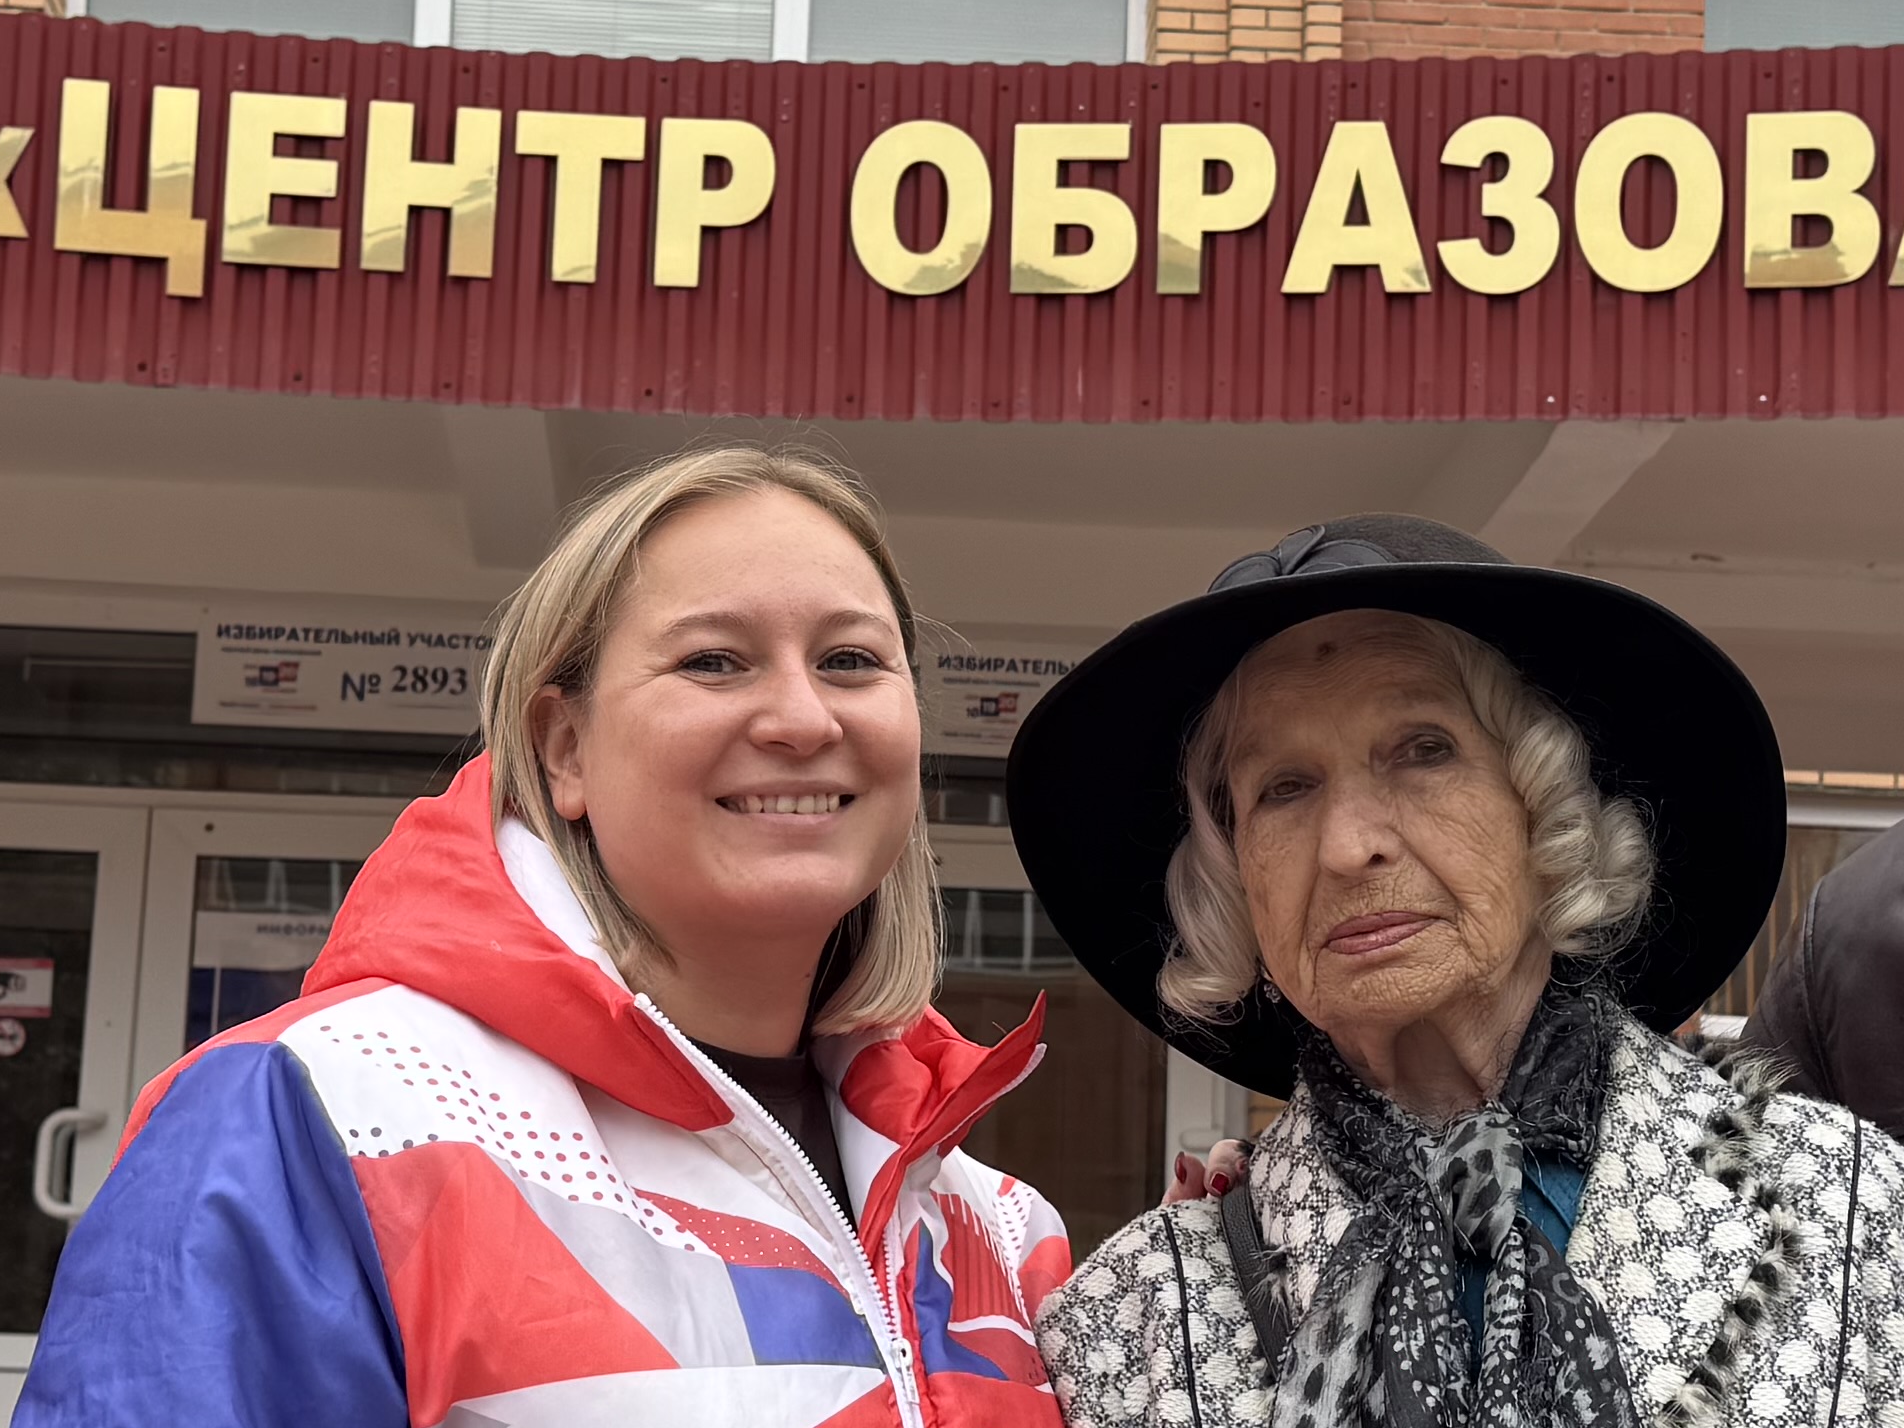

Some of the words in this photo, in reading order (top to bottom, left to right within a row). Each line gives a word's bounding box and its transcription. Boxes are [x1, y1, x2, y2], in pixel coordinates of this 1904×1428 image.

[217, 623, 400, 645] ИЗБИРАТЕЛЬНЫЙ
[938, 655, 1075, 676] ИЗБИРАТЕЛЬ
[392, 664, 468, 696] 2893
